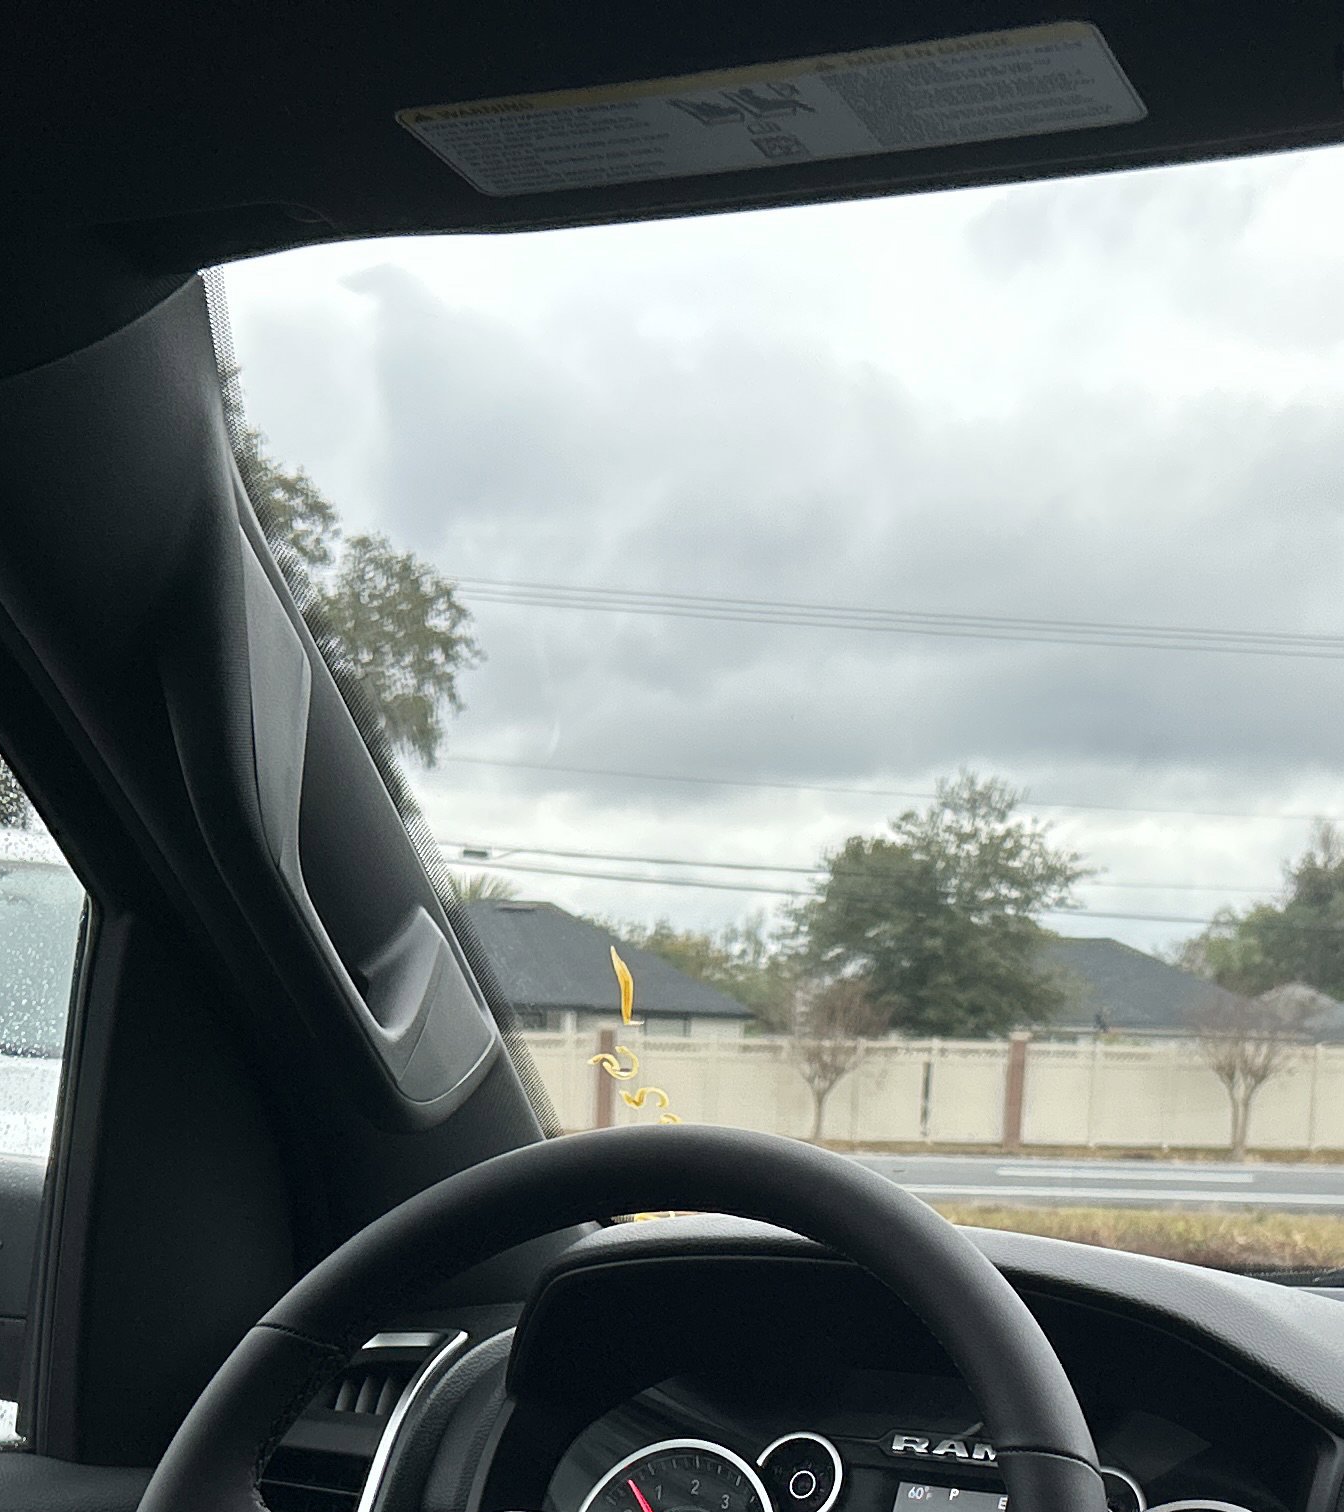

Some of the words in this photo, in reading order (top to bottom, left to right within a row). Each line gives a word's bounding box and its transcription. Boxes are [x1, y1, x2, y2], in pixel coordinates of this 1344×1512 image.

[655, 1484, 664, 1501] 1
[689, 1478, 701, 1496] 2
[948, 1487, 960, 1501] P
[720, 1493, 731, 1510] 3
